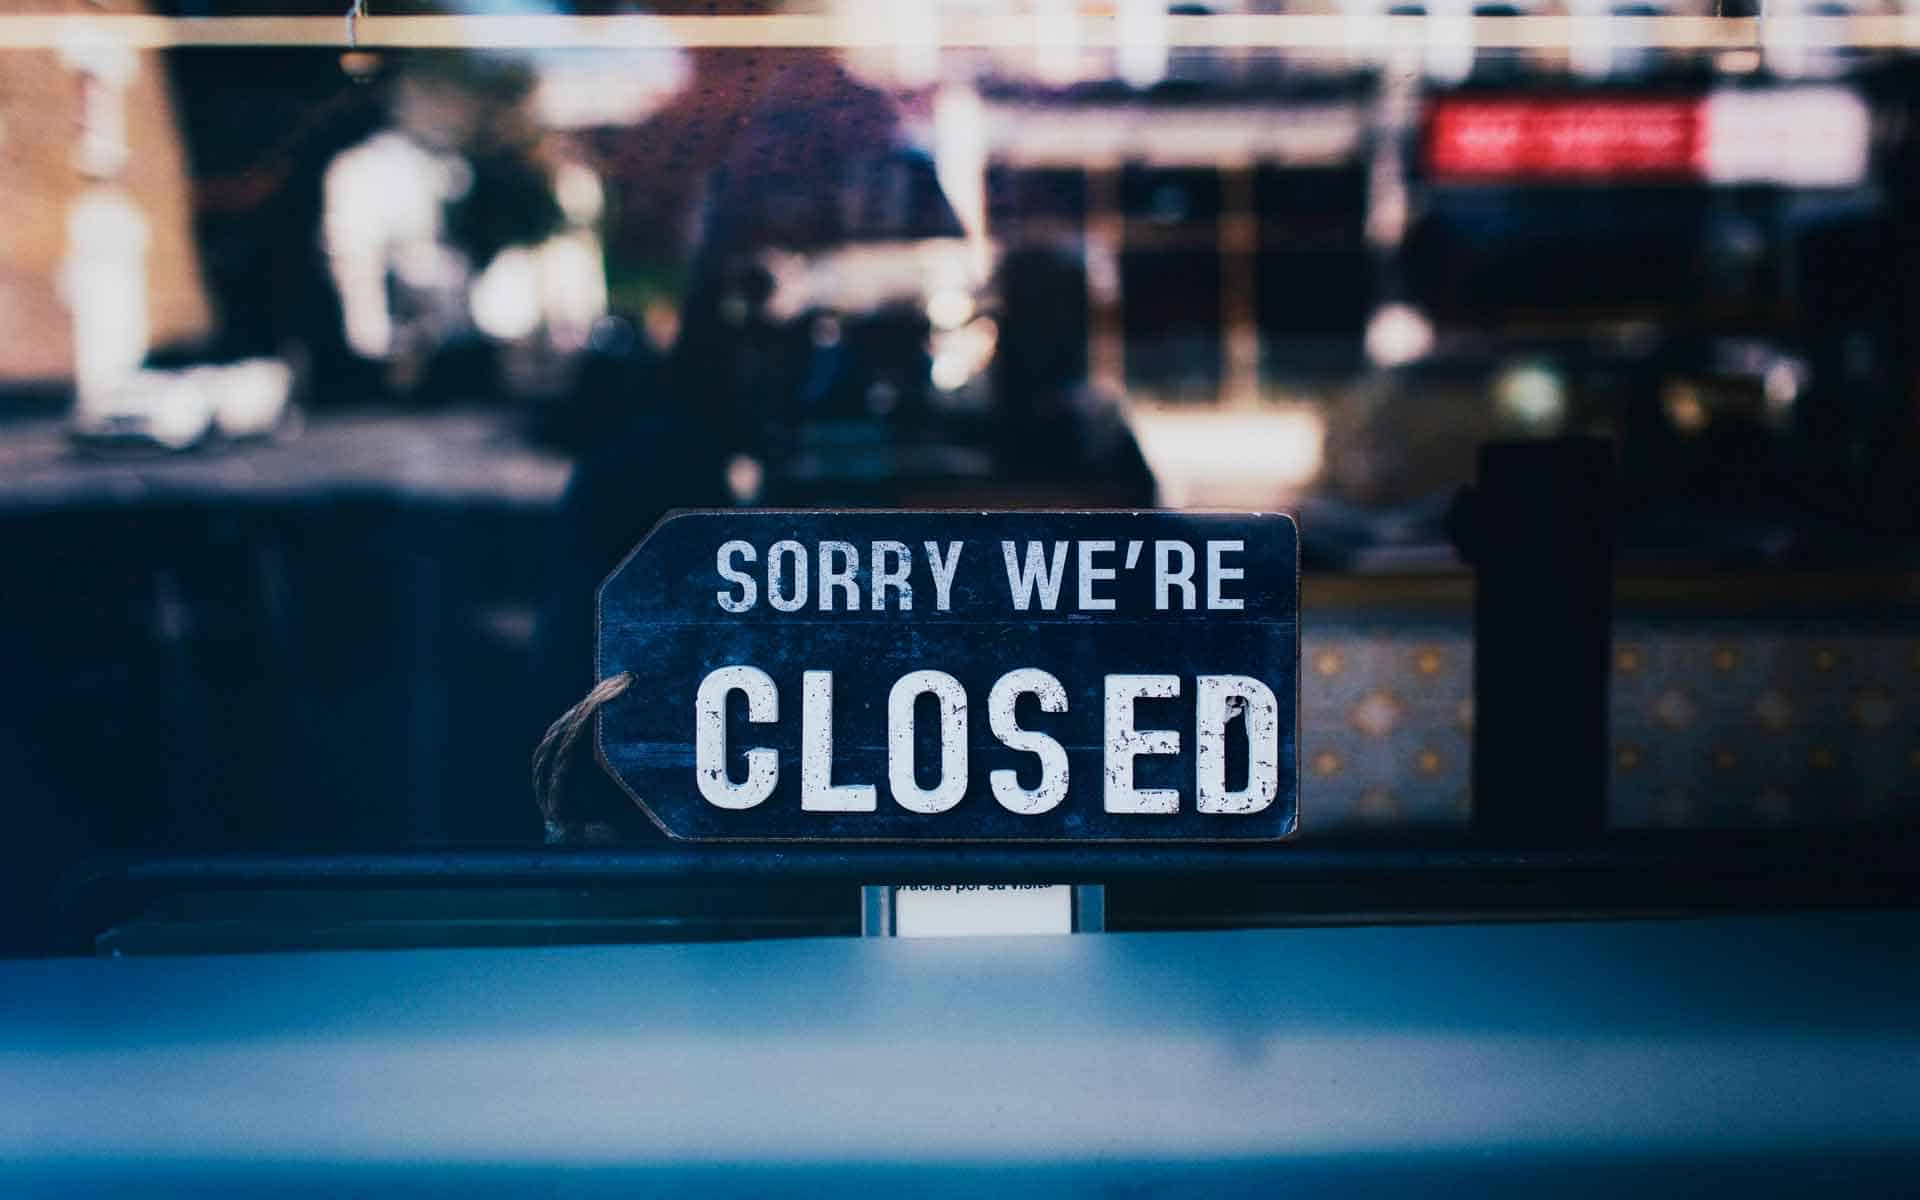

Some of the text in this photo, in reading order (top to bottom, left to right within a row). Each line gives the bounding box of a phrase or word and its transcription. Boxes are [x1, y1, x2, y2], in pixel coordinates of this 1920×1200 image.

[716, 540, 1246, 613] SORRY WE'RE
[695, 664, 1279, 815] CLOSED
[955, 883, 980, 894] por
